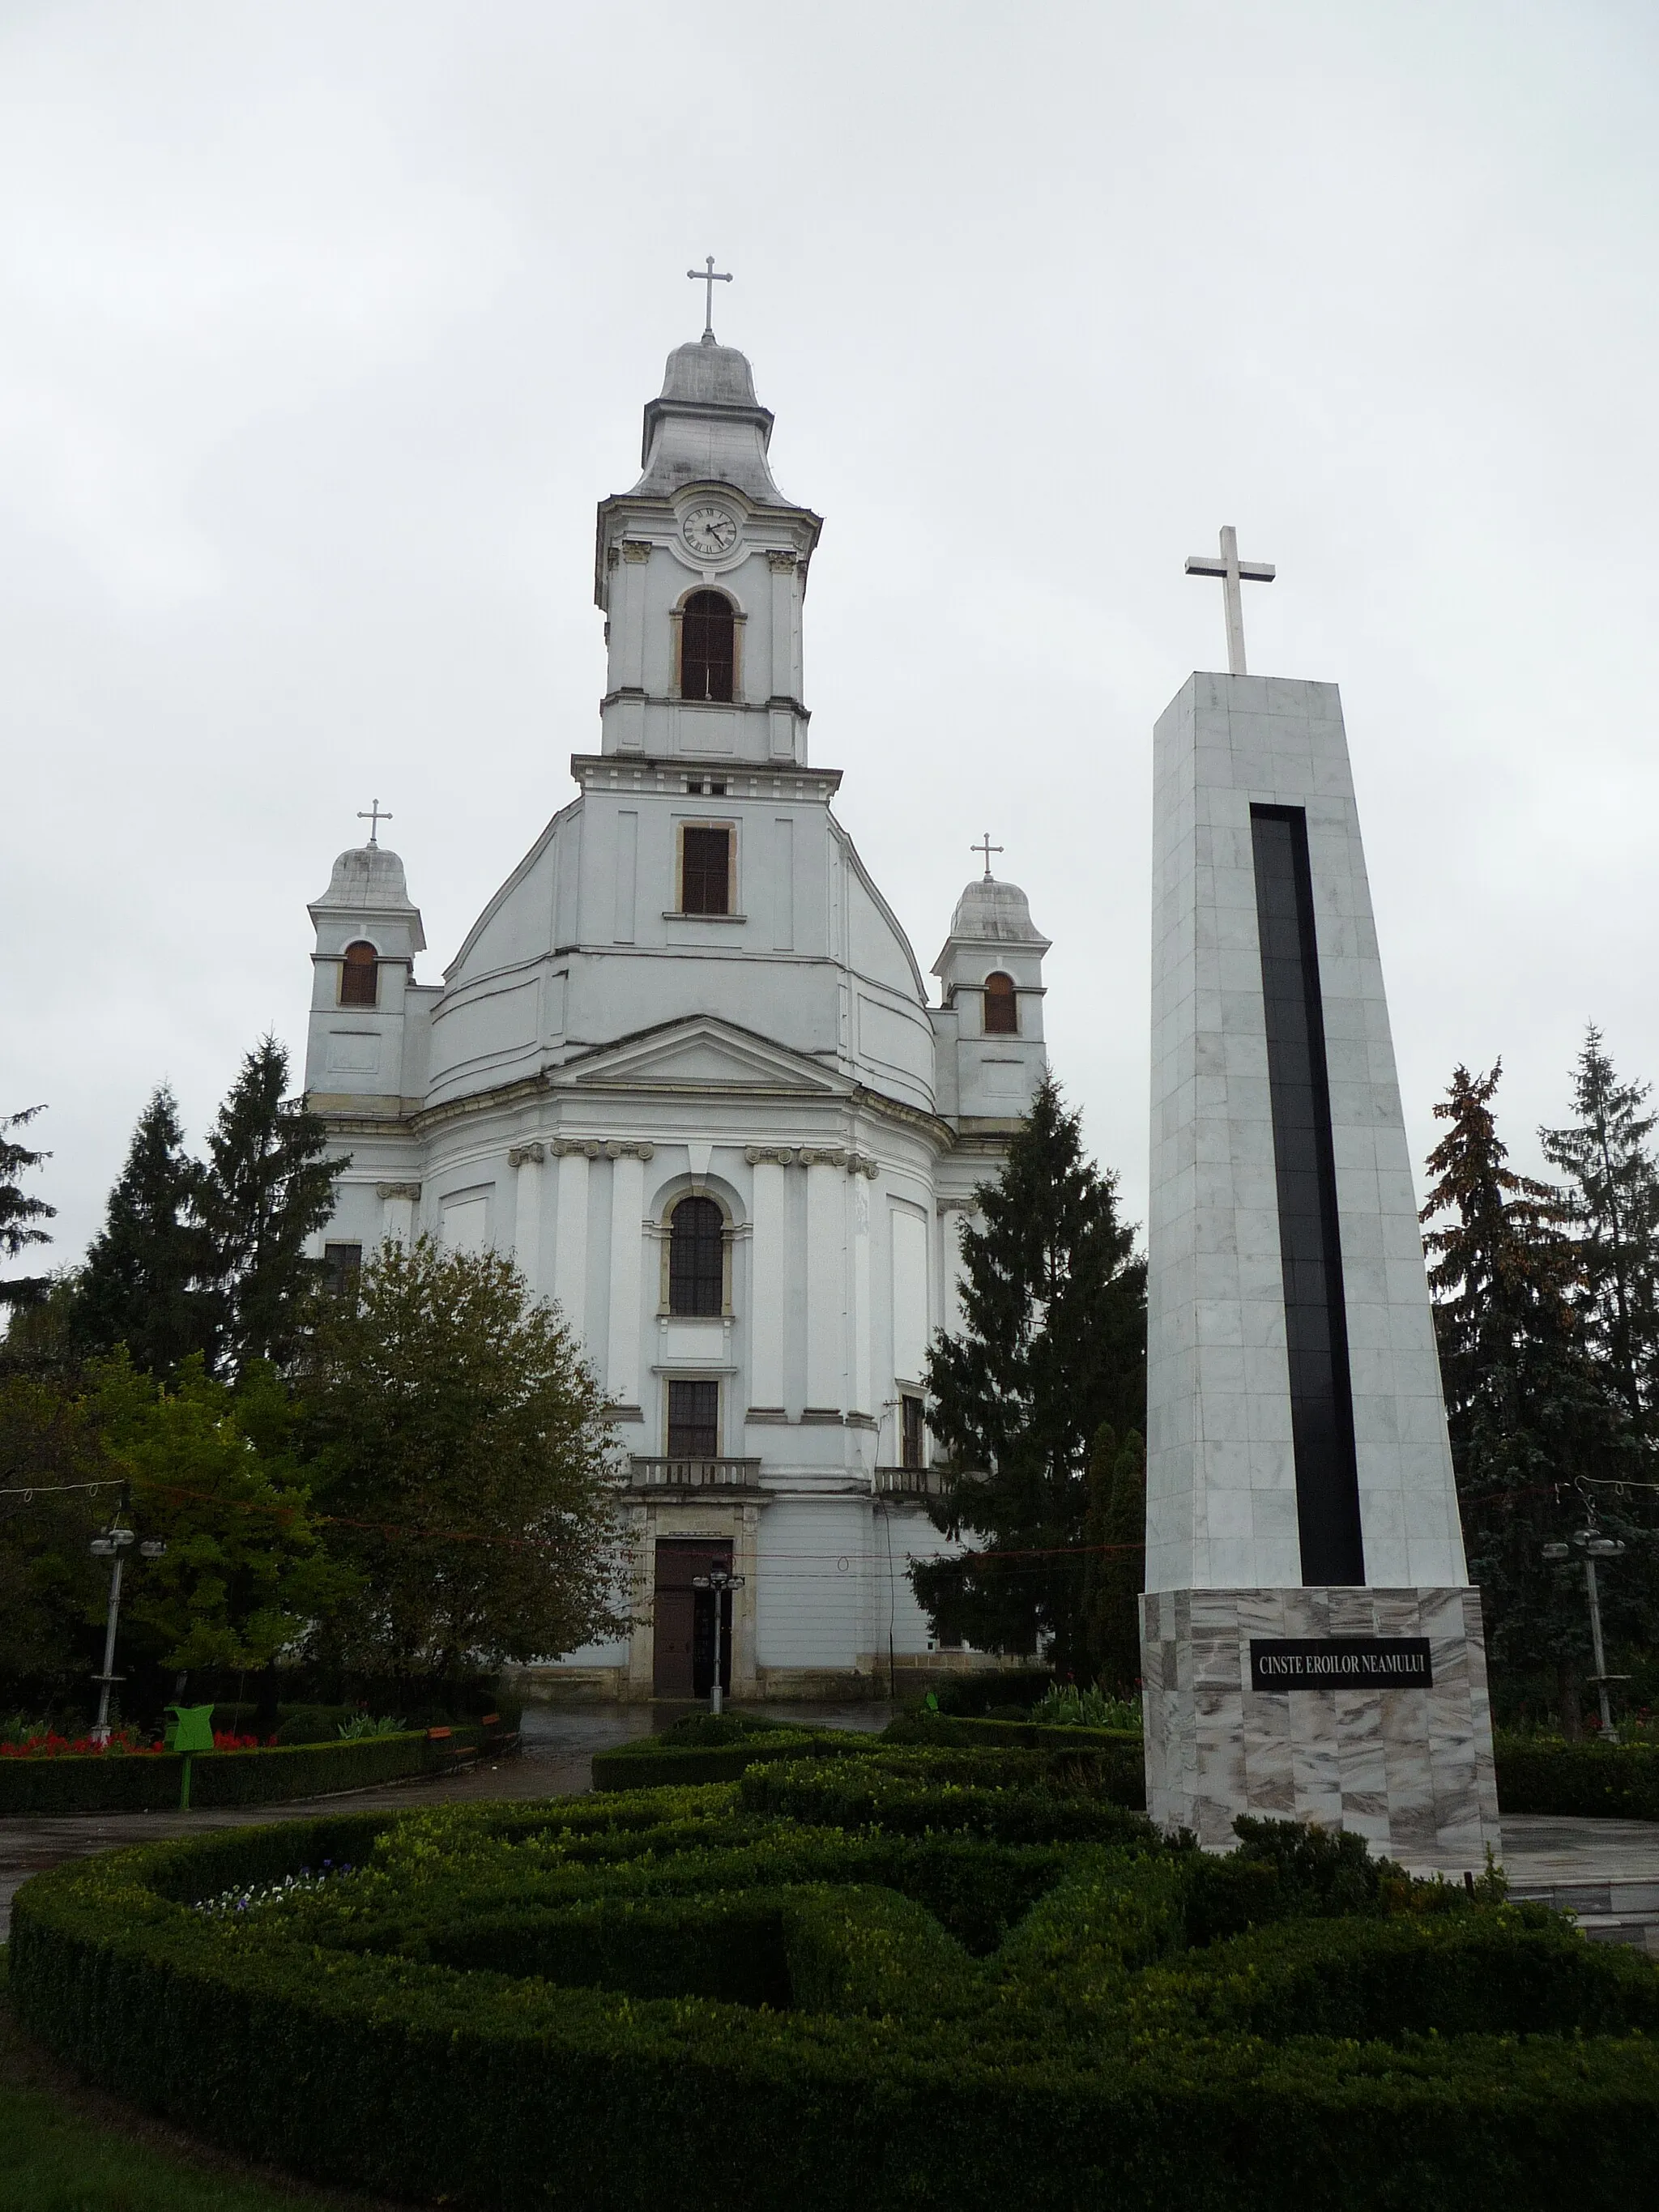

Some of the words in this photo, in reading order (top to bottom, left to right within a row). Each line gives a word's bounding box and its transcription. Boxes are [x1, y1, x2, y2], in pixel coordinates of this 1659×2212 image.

[1259, 1656, 1303, 1674] CINSTE
[1306, 1655, 1360, 1673] EROILOR
[1362, 1654, 1425, 1673] NEAMULUI
